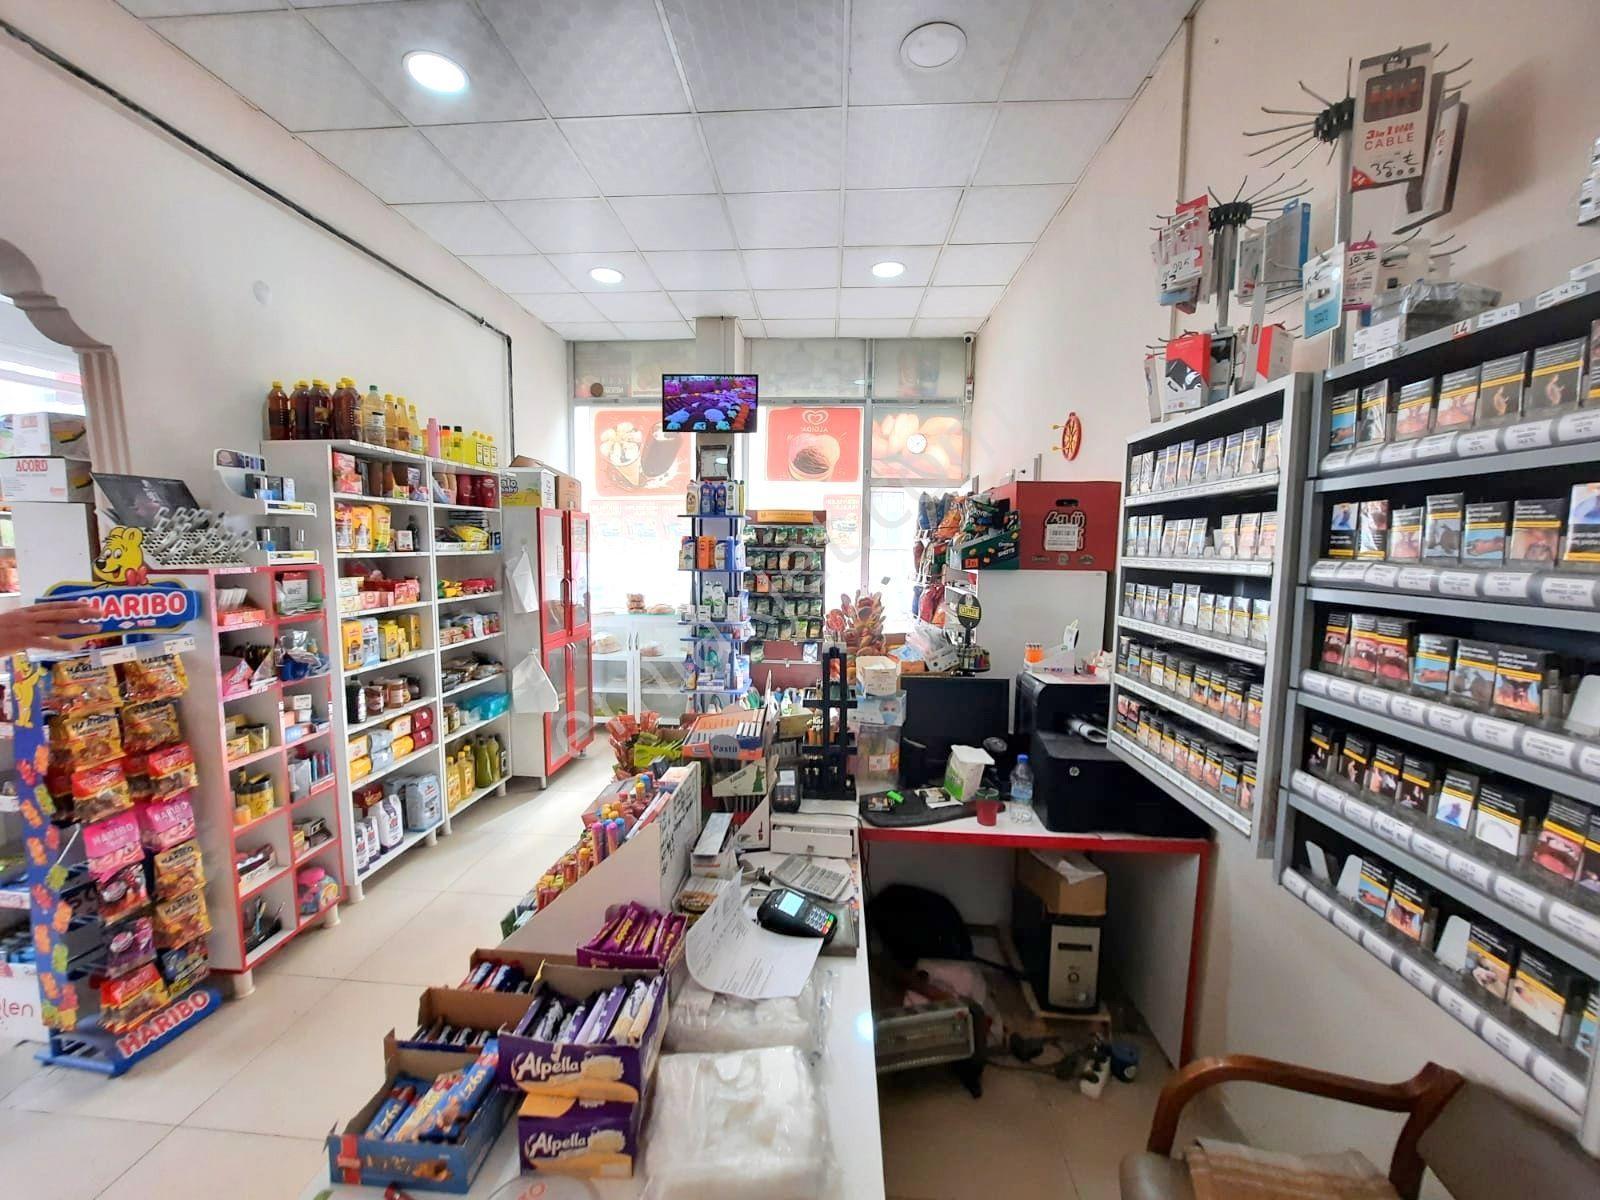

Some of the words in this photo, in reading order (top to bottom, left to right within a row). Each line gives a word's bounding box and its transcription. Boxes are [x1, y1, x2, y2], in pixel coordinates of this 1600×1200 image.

[1364, 132, 1415, 151] CABLE
[16, 460, 48, 472] ACORD
[713, 744, 738, 753] Pastil
[117, 990, 210, 1058] HARIBO
[515, 1051, 580, 1081] Alpella
[528, 1131, 587, 1159] Alpella
